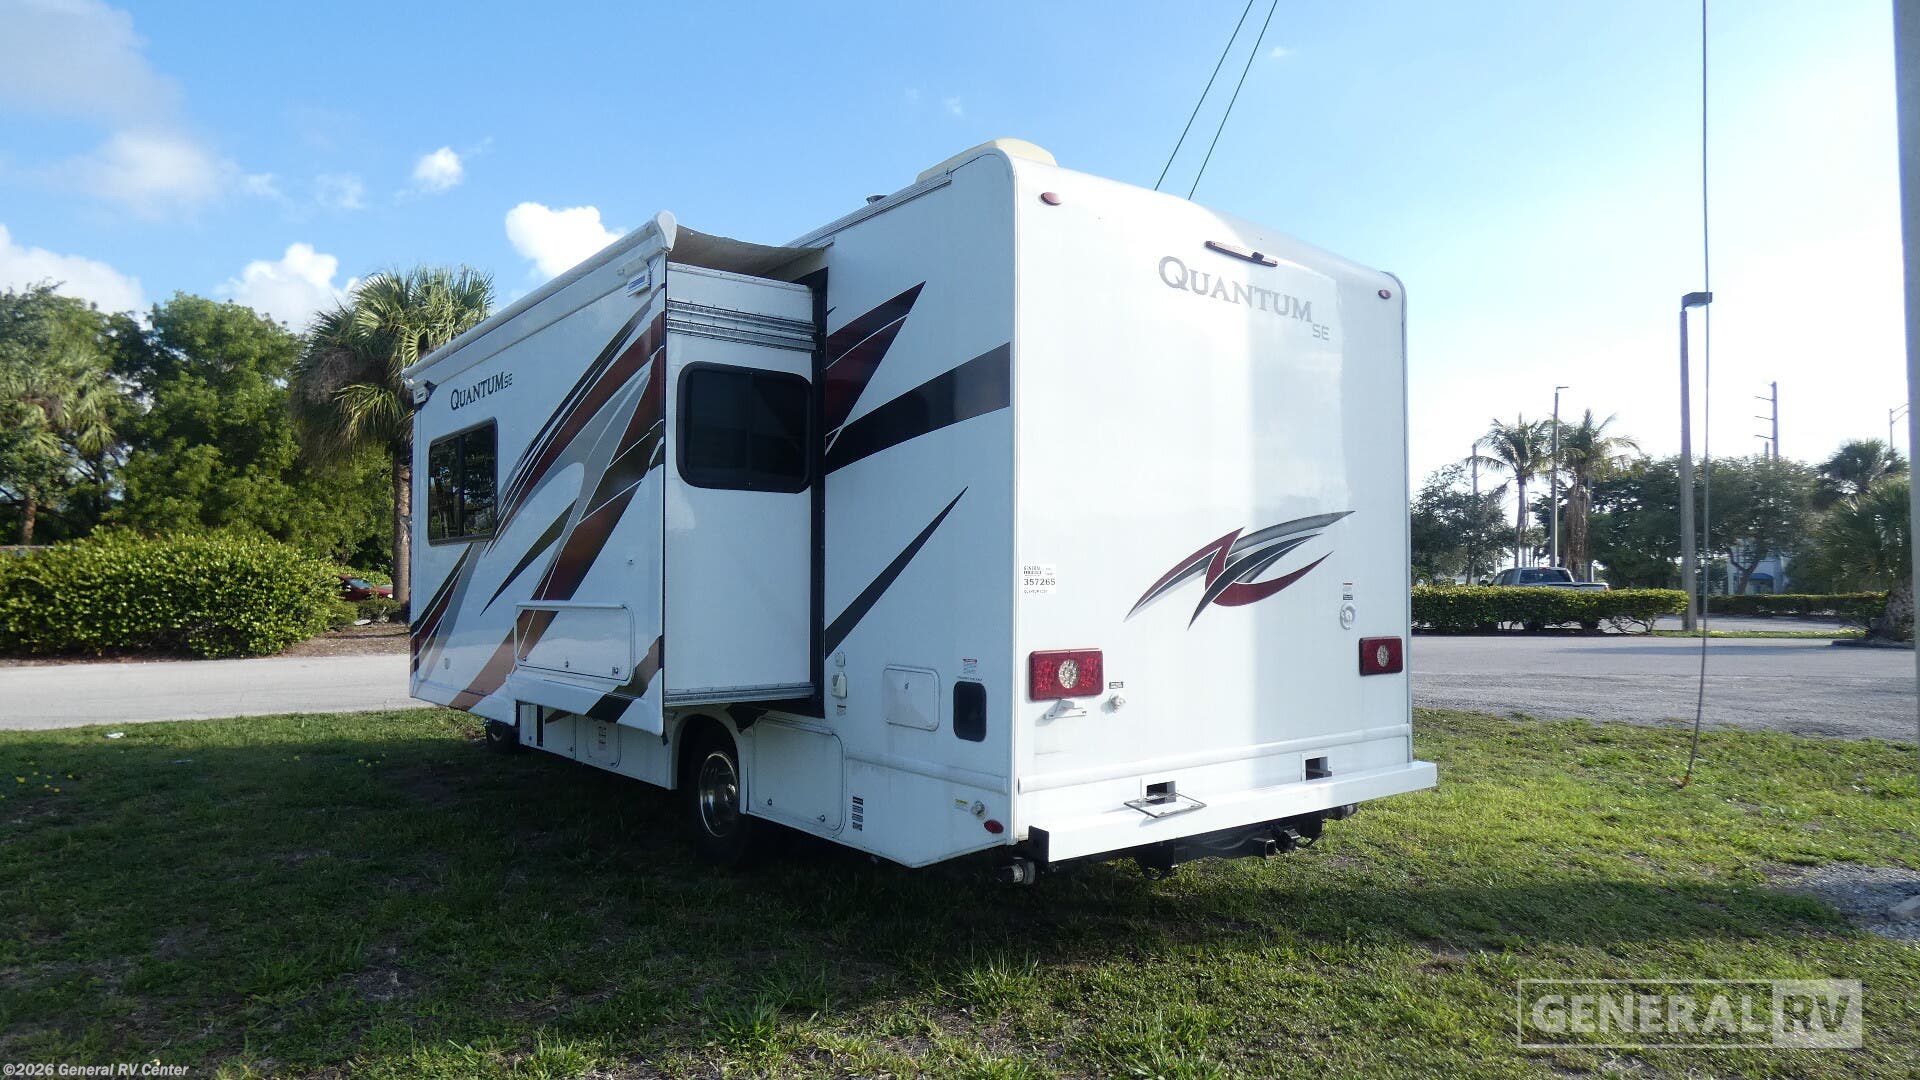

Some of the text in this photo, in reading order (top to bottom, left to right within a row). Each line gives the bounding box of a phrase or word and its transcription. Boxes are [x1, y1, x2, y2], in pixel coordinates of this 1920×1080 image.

[1158, 255, 1313, 323] QUANTUM
[1312, 323, 1330, 341] SE
[450, 371, 504, 410] QUANTUM
[1023, 578, 1056, 586] 357265
